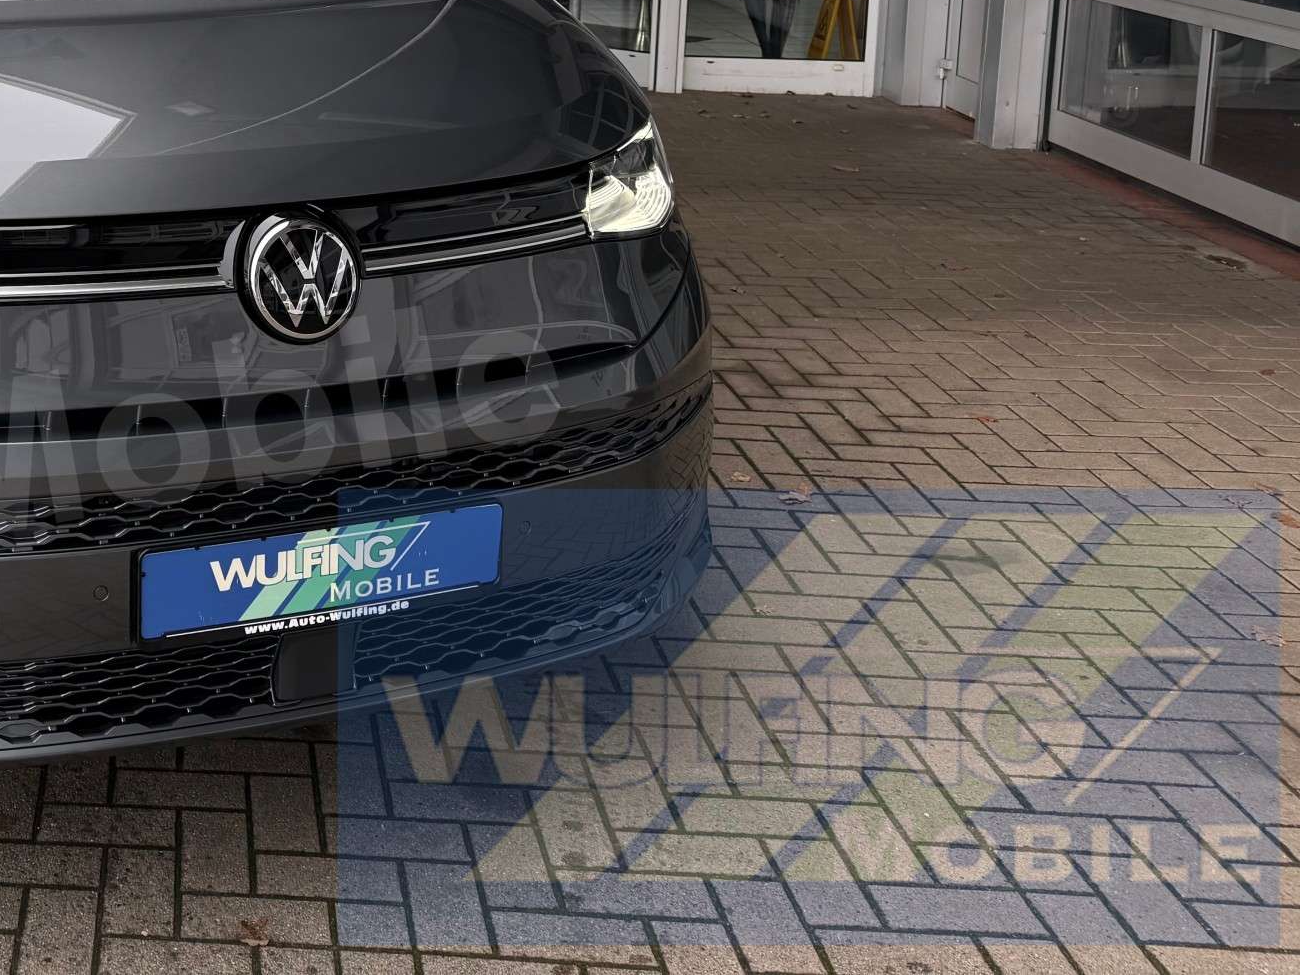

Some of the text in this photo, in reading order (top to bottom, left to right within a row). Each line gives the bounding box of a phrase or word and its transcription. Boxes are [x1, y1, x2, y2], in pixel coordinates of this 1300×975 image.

[209, 535, 397, 593] WULFING
[329, 569, 441, 603] MOBILE
[244, 599, 410, 635] www.Auto-Wulfing.de
